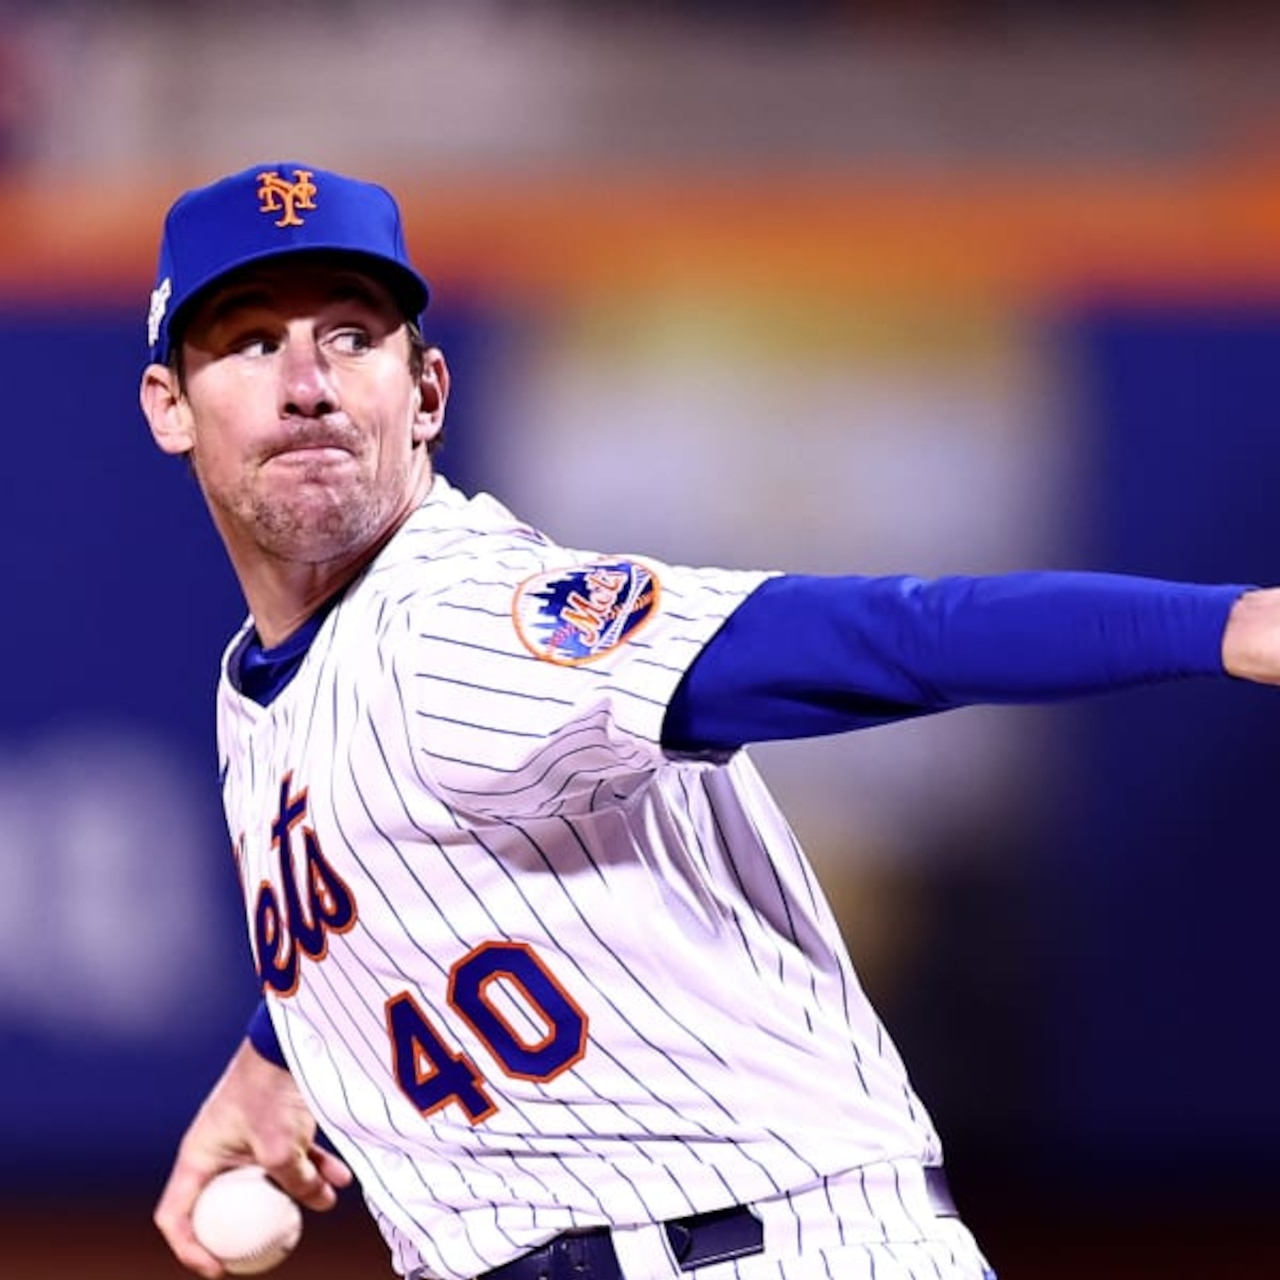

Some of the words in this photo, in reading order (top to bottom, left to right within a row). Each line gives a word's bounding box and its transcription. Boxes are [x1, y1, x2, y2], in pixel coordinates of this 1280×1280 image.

[255, 169, 318, 227] NY
[235, 769, 359, 998] ets
[383, 940, 590, 1126] 40
